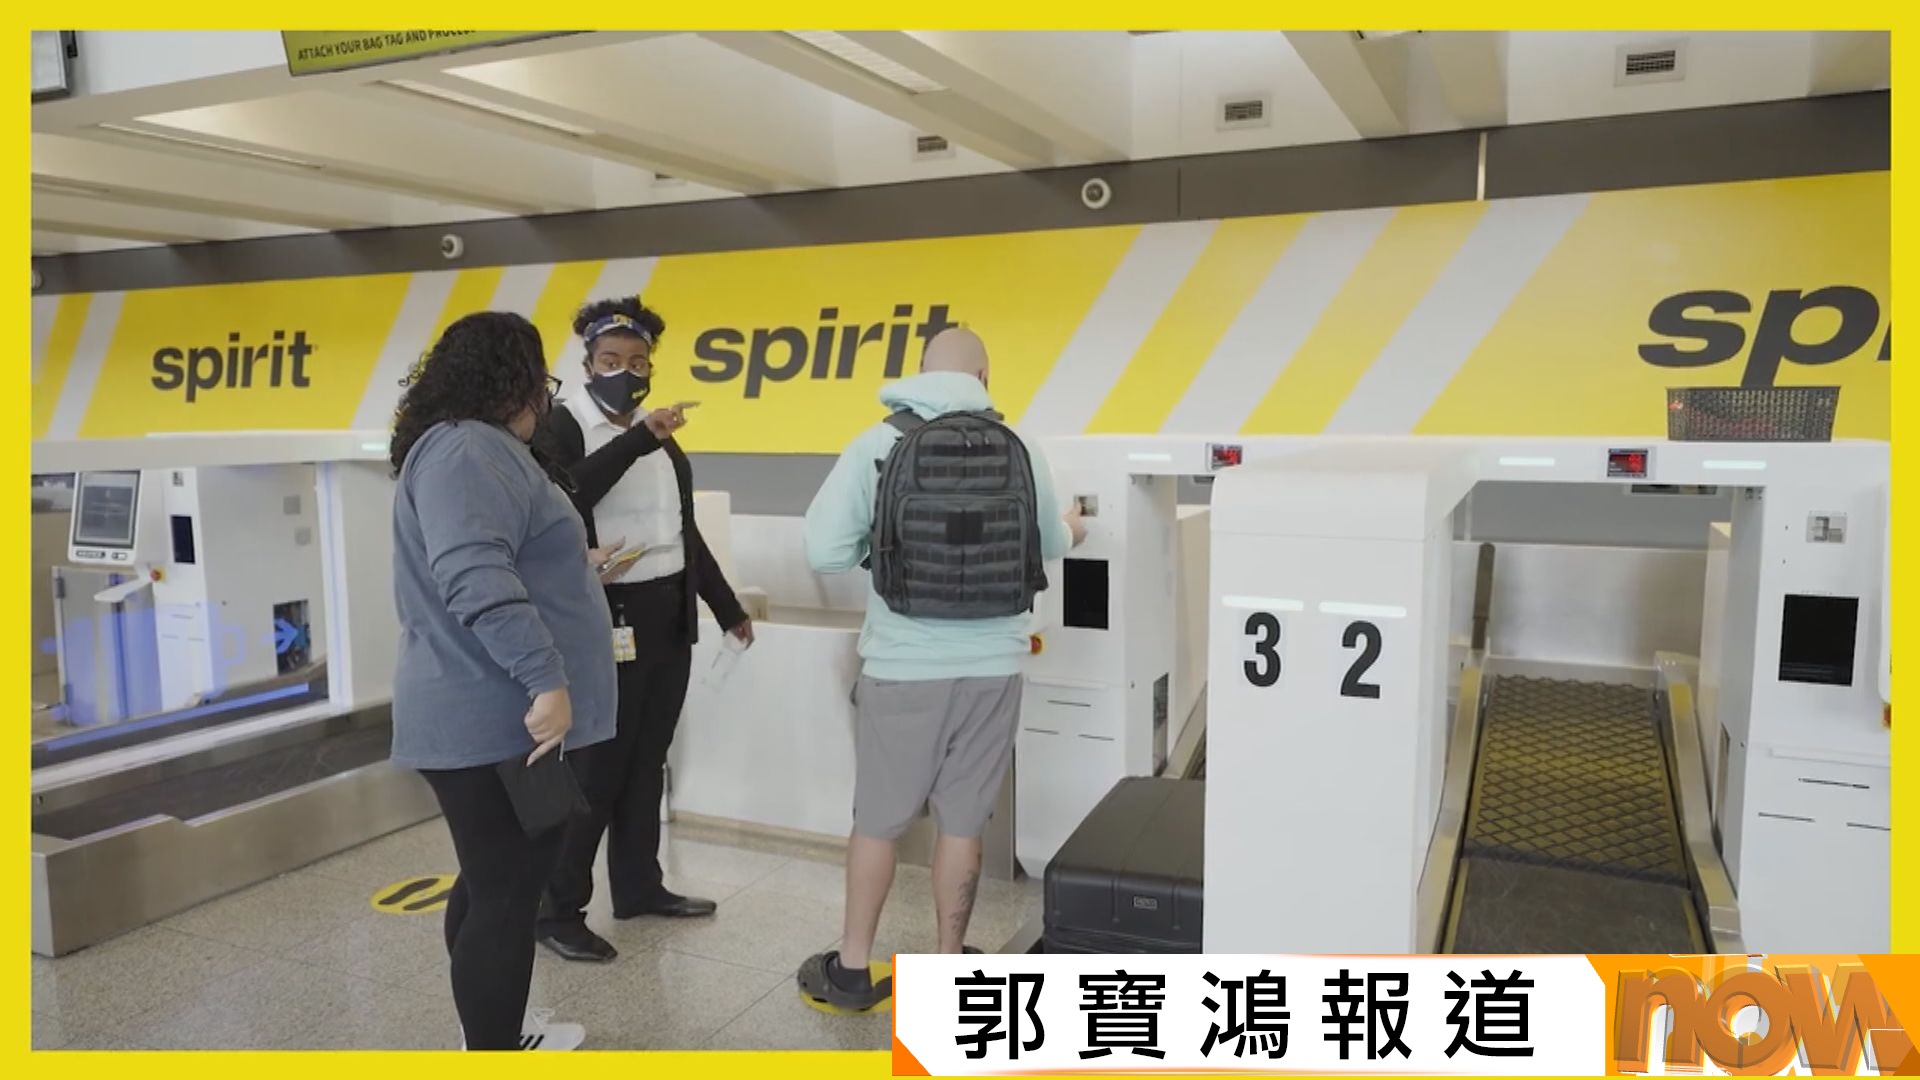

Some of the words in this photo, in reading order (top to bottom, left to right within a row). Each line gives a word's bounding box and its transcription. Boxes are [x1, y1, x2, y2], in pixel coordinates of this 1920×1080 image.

[298, 44, 333, 60] ATTACH
[334, 40, 361, 55] YOUR
[362, 36, 383, 50] BAG
[385, 32, 403, 46] TAG
[406, 30, 428, 43] AND
[152, 330, 312, 403] spirit
[1638, 286, 1891, 387] sp
[1244, 612, 1281, 687] 3
[1340, 620, 1382, 699] 2
